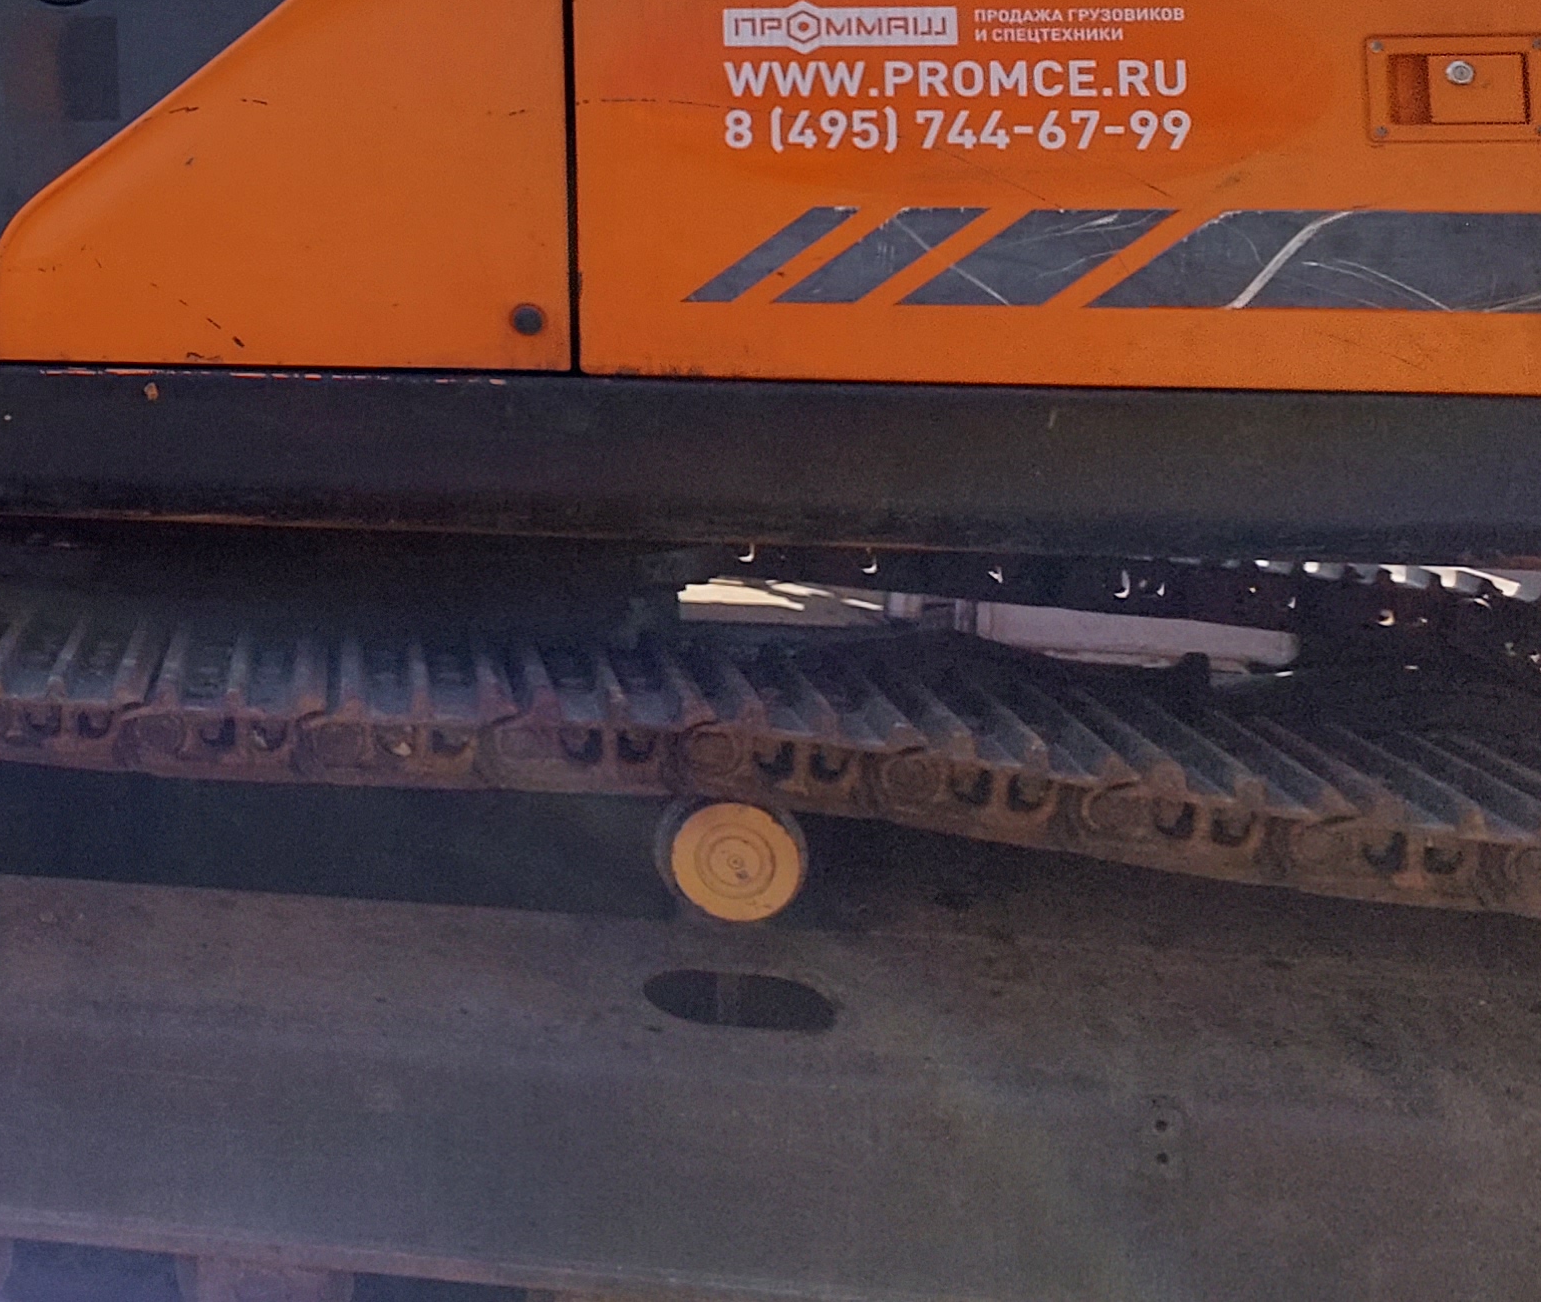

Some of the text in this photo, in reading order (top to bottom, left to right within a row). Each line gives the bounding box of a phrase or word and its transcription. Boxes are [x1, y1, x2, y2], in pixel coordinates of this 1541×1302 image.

[733, 9, 947, 44] ПРОММАШ
[974, 7, 1185, 24] ПРОДАЖА ГРУЗОВИКОВ
[975, 27, 1123, 43] И СПЕЦТЕХНИКИ
[723, 59, 1187, 97] WWW.PROMCE.RU
[724, 105, 1192, 153] 8 (495) 744-67-99
